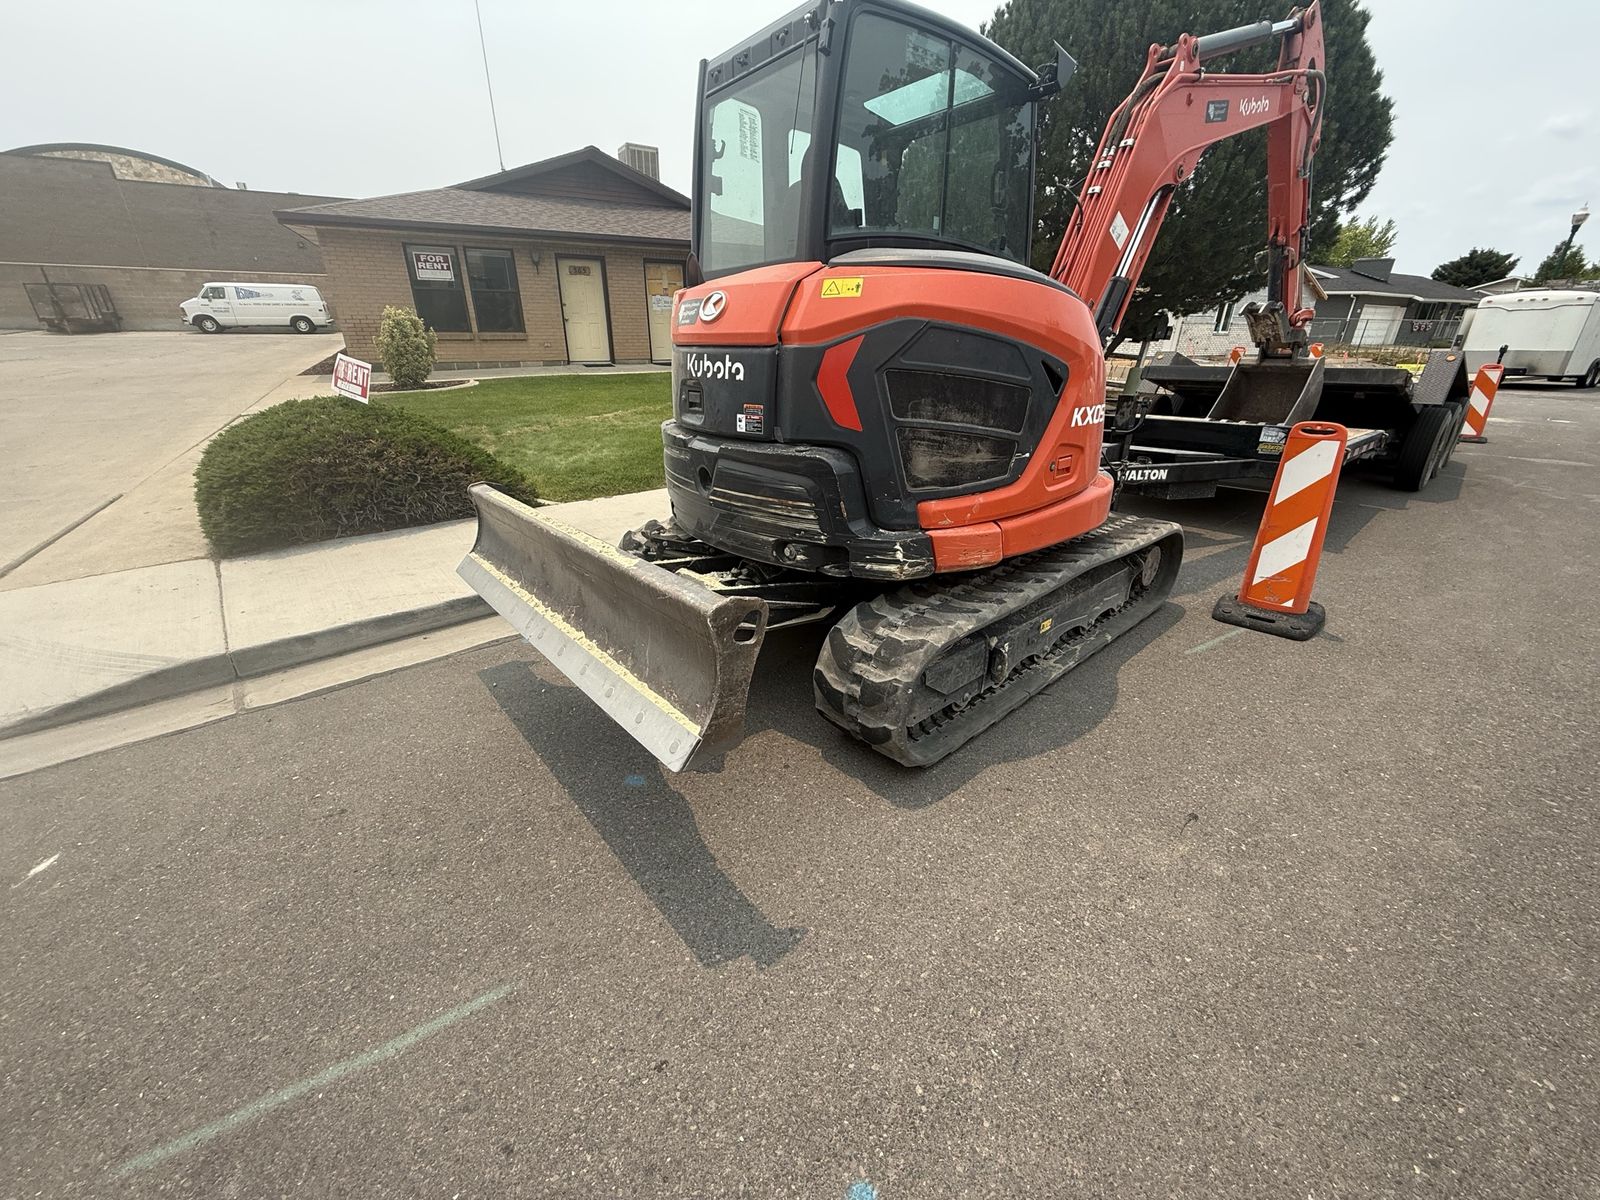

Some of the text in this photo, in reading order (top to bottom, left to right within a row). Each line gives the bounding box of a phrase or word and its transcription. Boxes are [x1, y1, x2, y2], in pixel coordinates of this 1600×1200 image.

[1240, 96, 1269, 116] Kubota
[417, 262, 449, 270] RENT
[346, 361, 369, 387] RENT
[687, 353, 745, 381] Kubota
